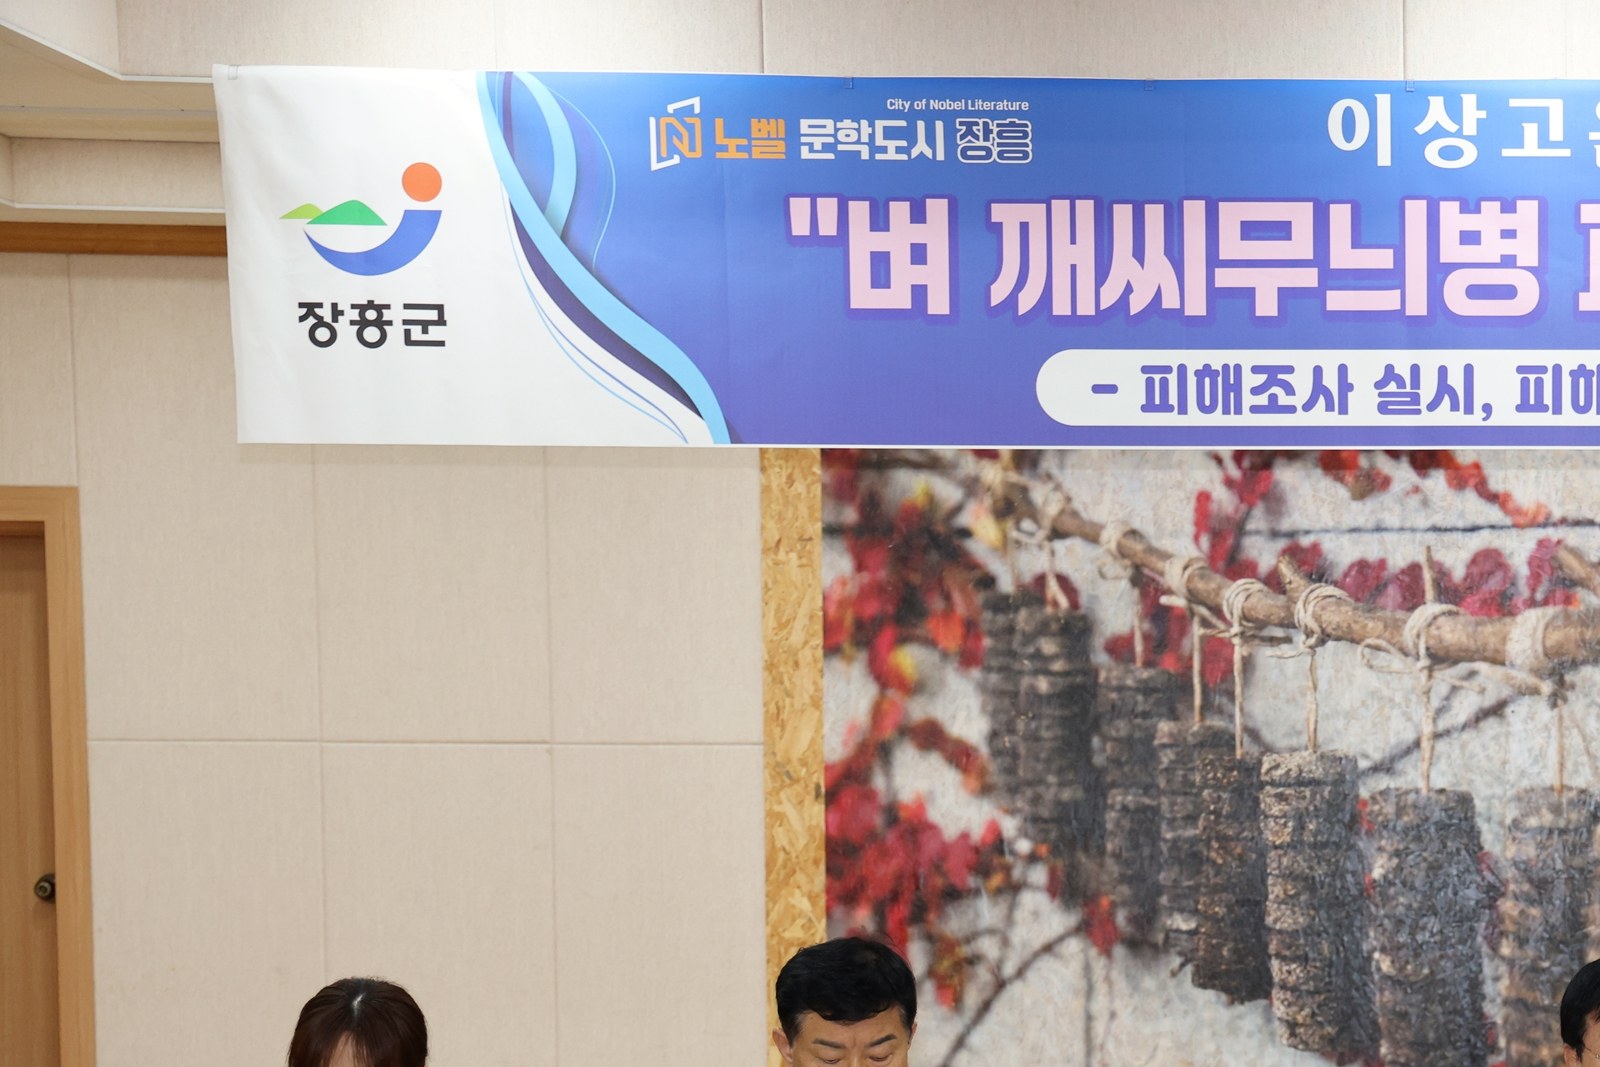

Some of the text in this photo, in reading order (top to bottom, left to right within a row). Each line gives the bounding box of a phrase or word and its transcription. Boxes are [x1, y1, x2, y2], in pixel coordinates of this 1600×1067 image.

[886, 98, 1030, 113] City of Nobel Literature
[715, 116, 1033, 165] 노벨 문학도시 장흥
[786, 195, 954, 317] "벼
[988, 196, 1542, 319] 깨씨무늬병
[296, 298, 449, 350] 장흥군
[1138, 362, 1356, 417] 피해조사
[1372, 362, 1495, 424] 실시,
